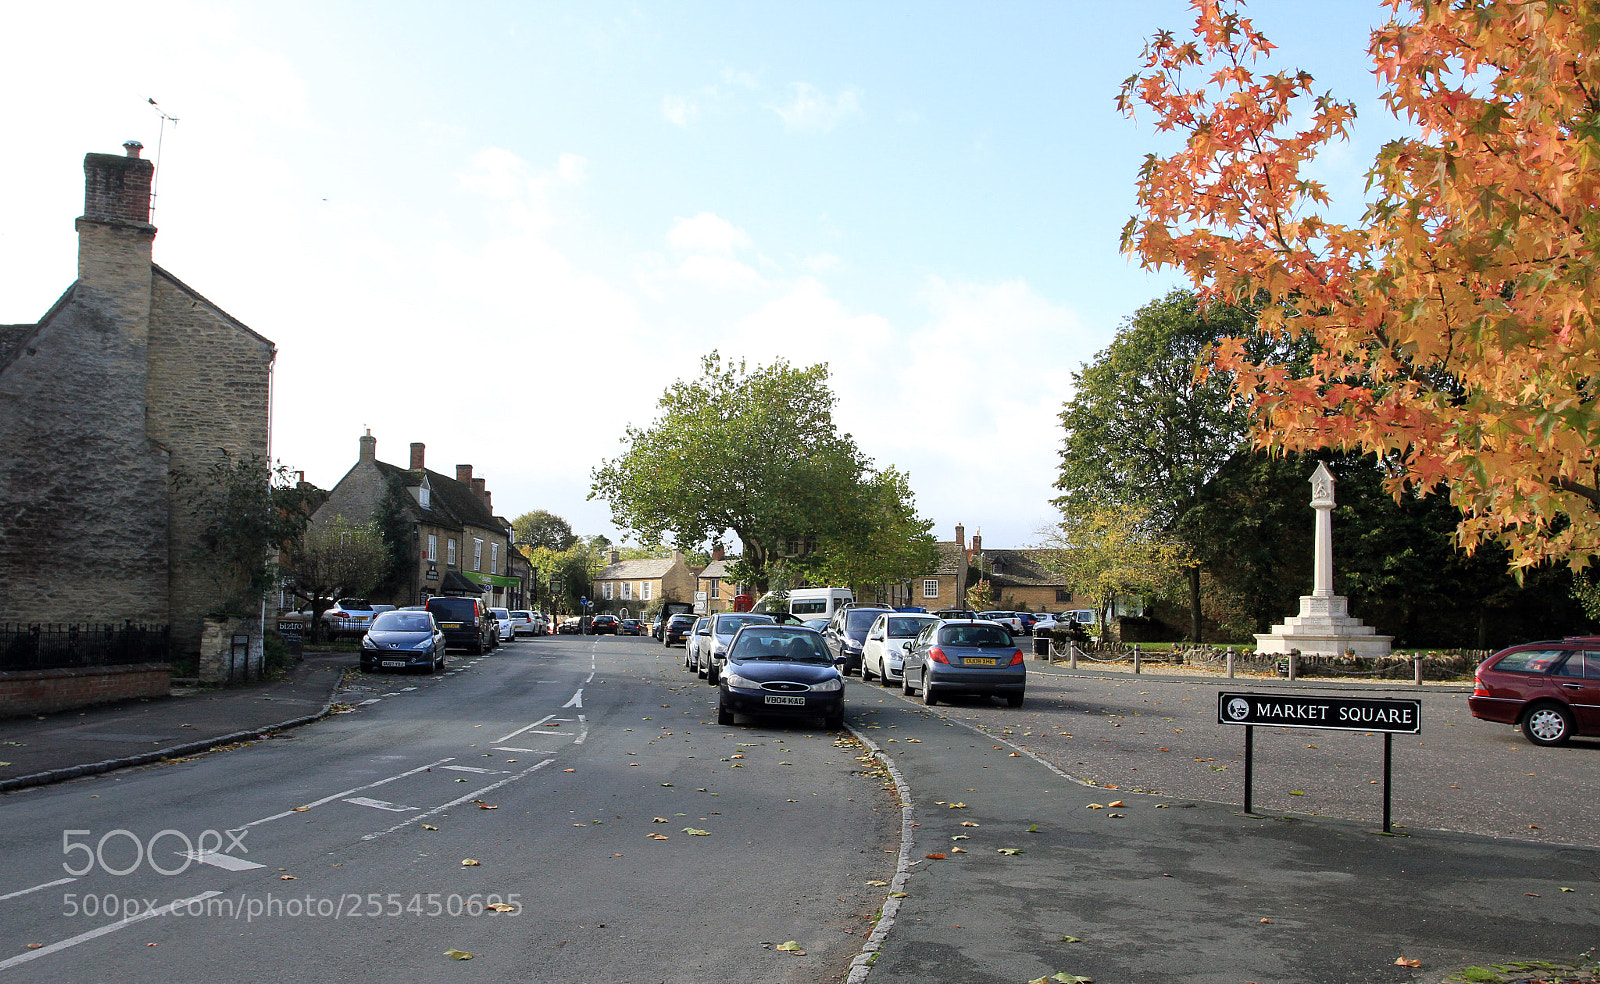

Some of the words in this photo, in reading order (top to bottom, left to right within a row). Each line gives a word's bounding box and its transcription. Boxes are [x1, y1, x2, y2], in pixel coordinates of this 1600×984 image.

[788, 697, 804, 705] KAG
[1256, 703, 1329, 720] MARKET
[1339, 706, 1412, 724] SQUARE
